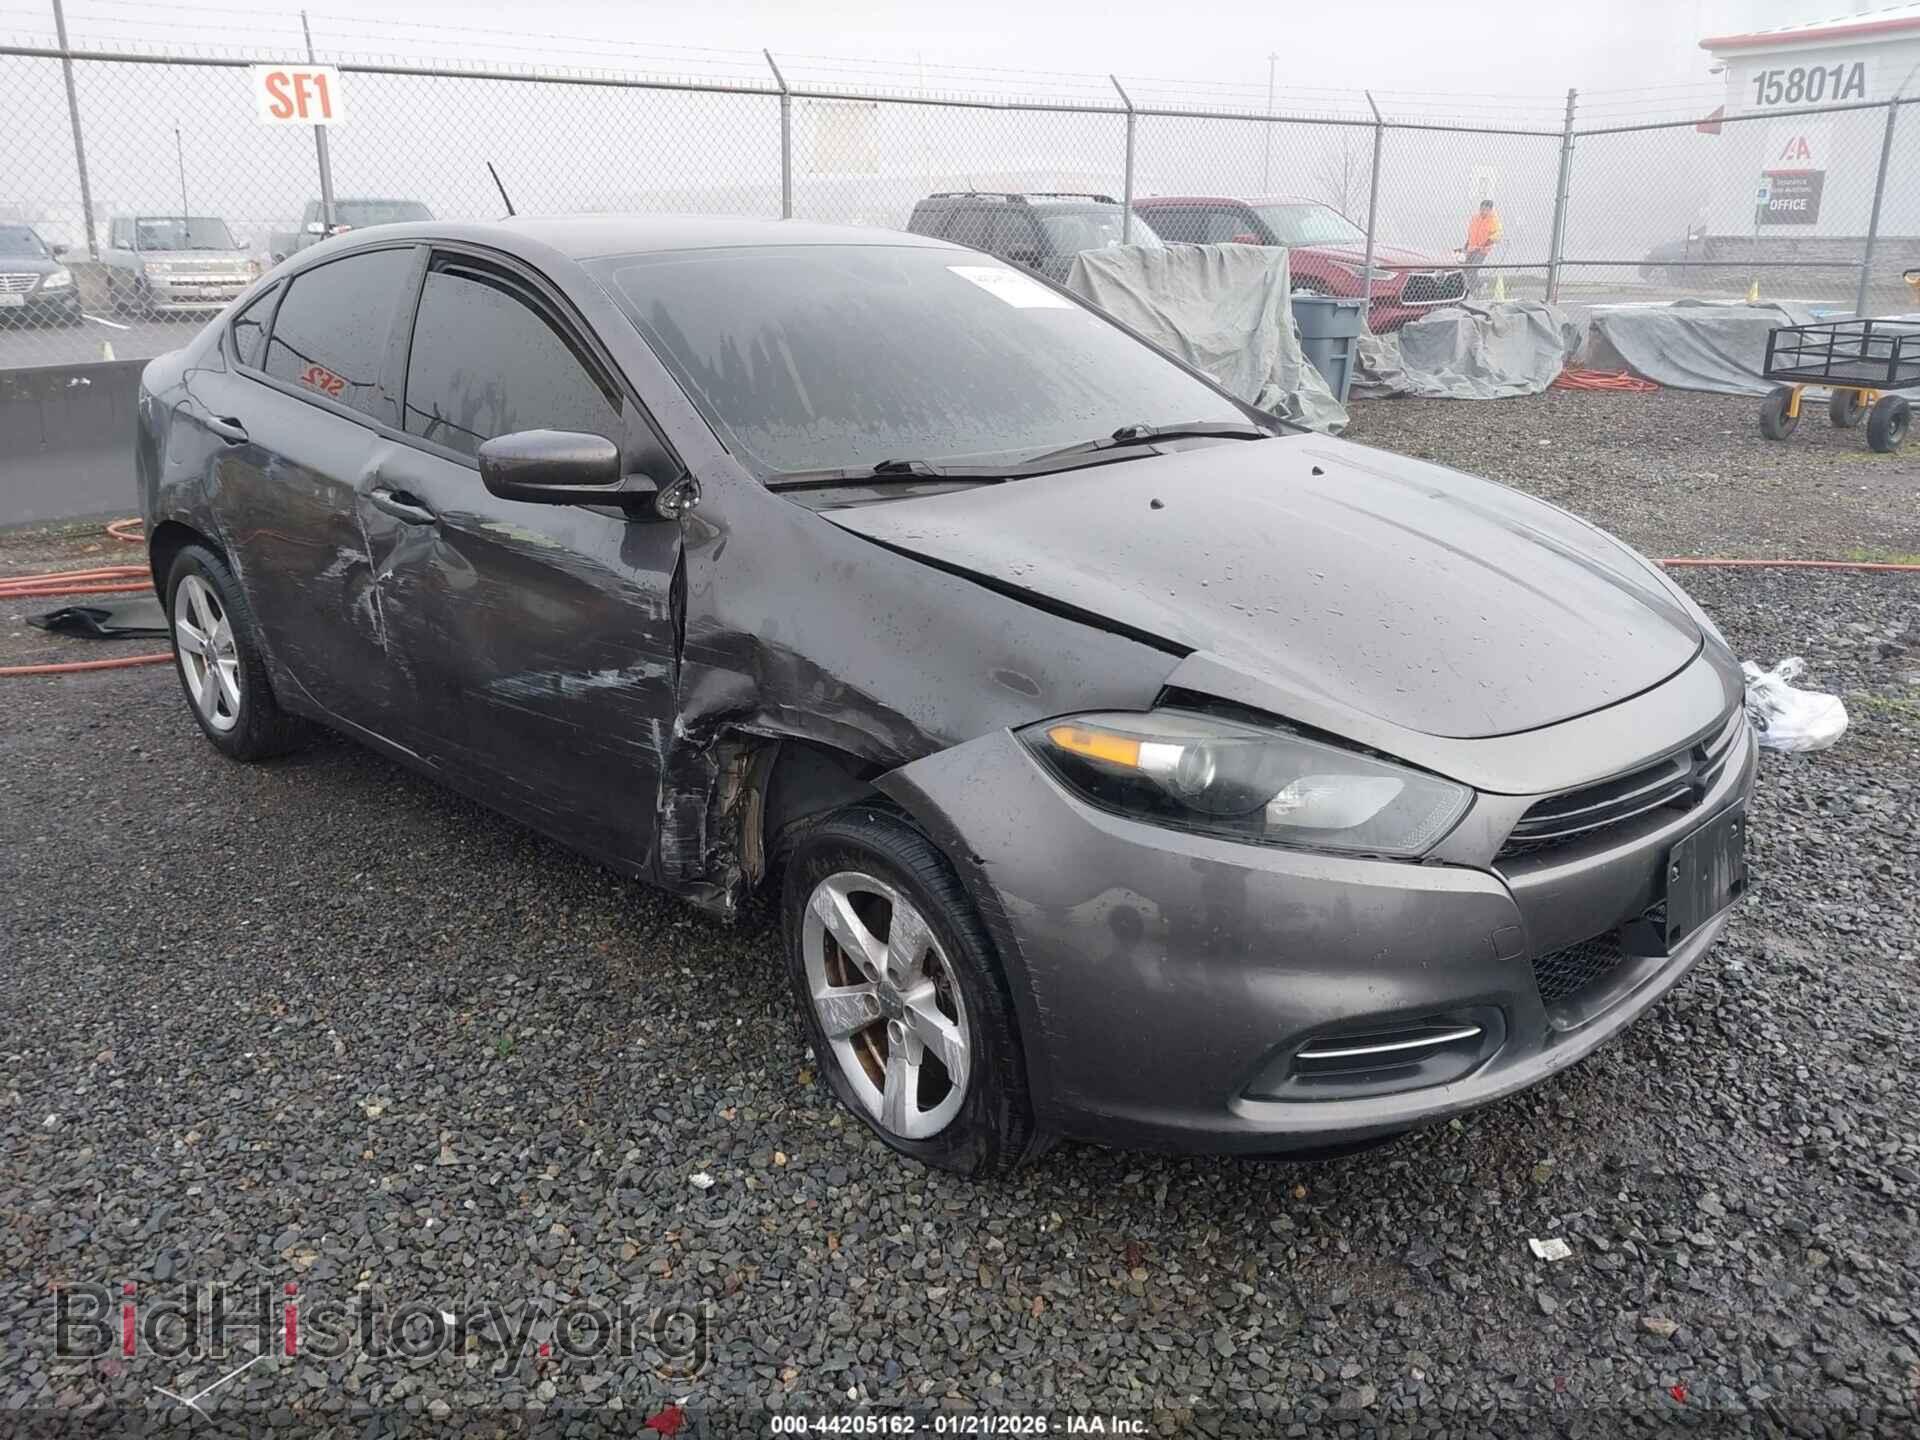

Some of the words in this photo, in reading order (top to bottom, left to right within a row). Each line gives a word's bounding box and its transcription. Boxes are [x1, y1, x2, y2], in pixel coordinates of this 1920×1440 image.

[265, 71, 332, 118] SF1
[1752, 62, 1865, 105] 15801A
[1769, 198, 1807, 211] OFFICE
